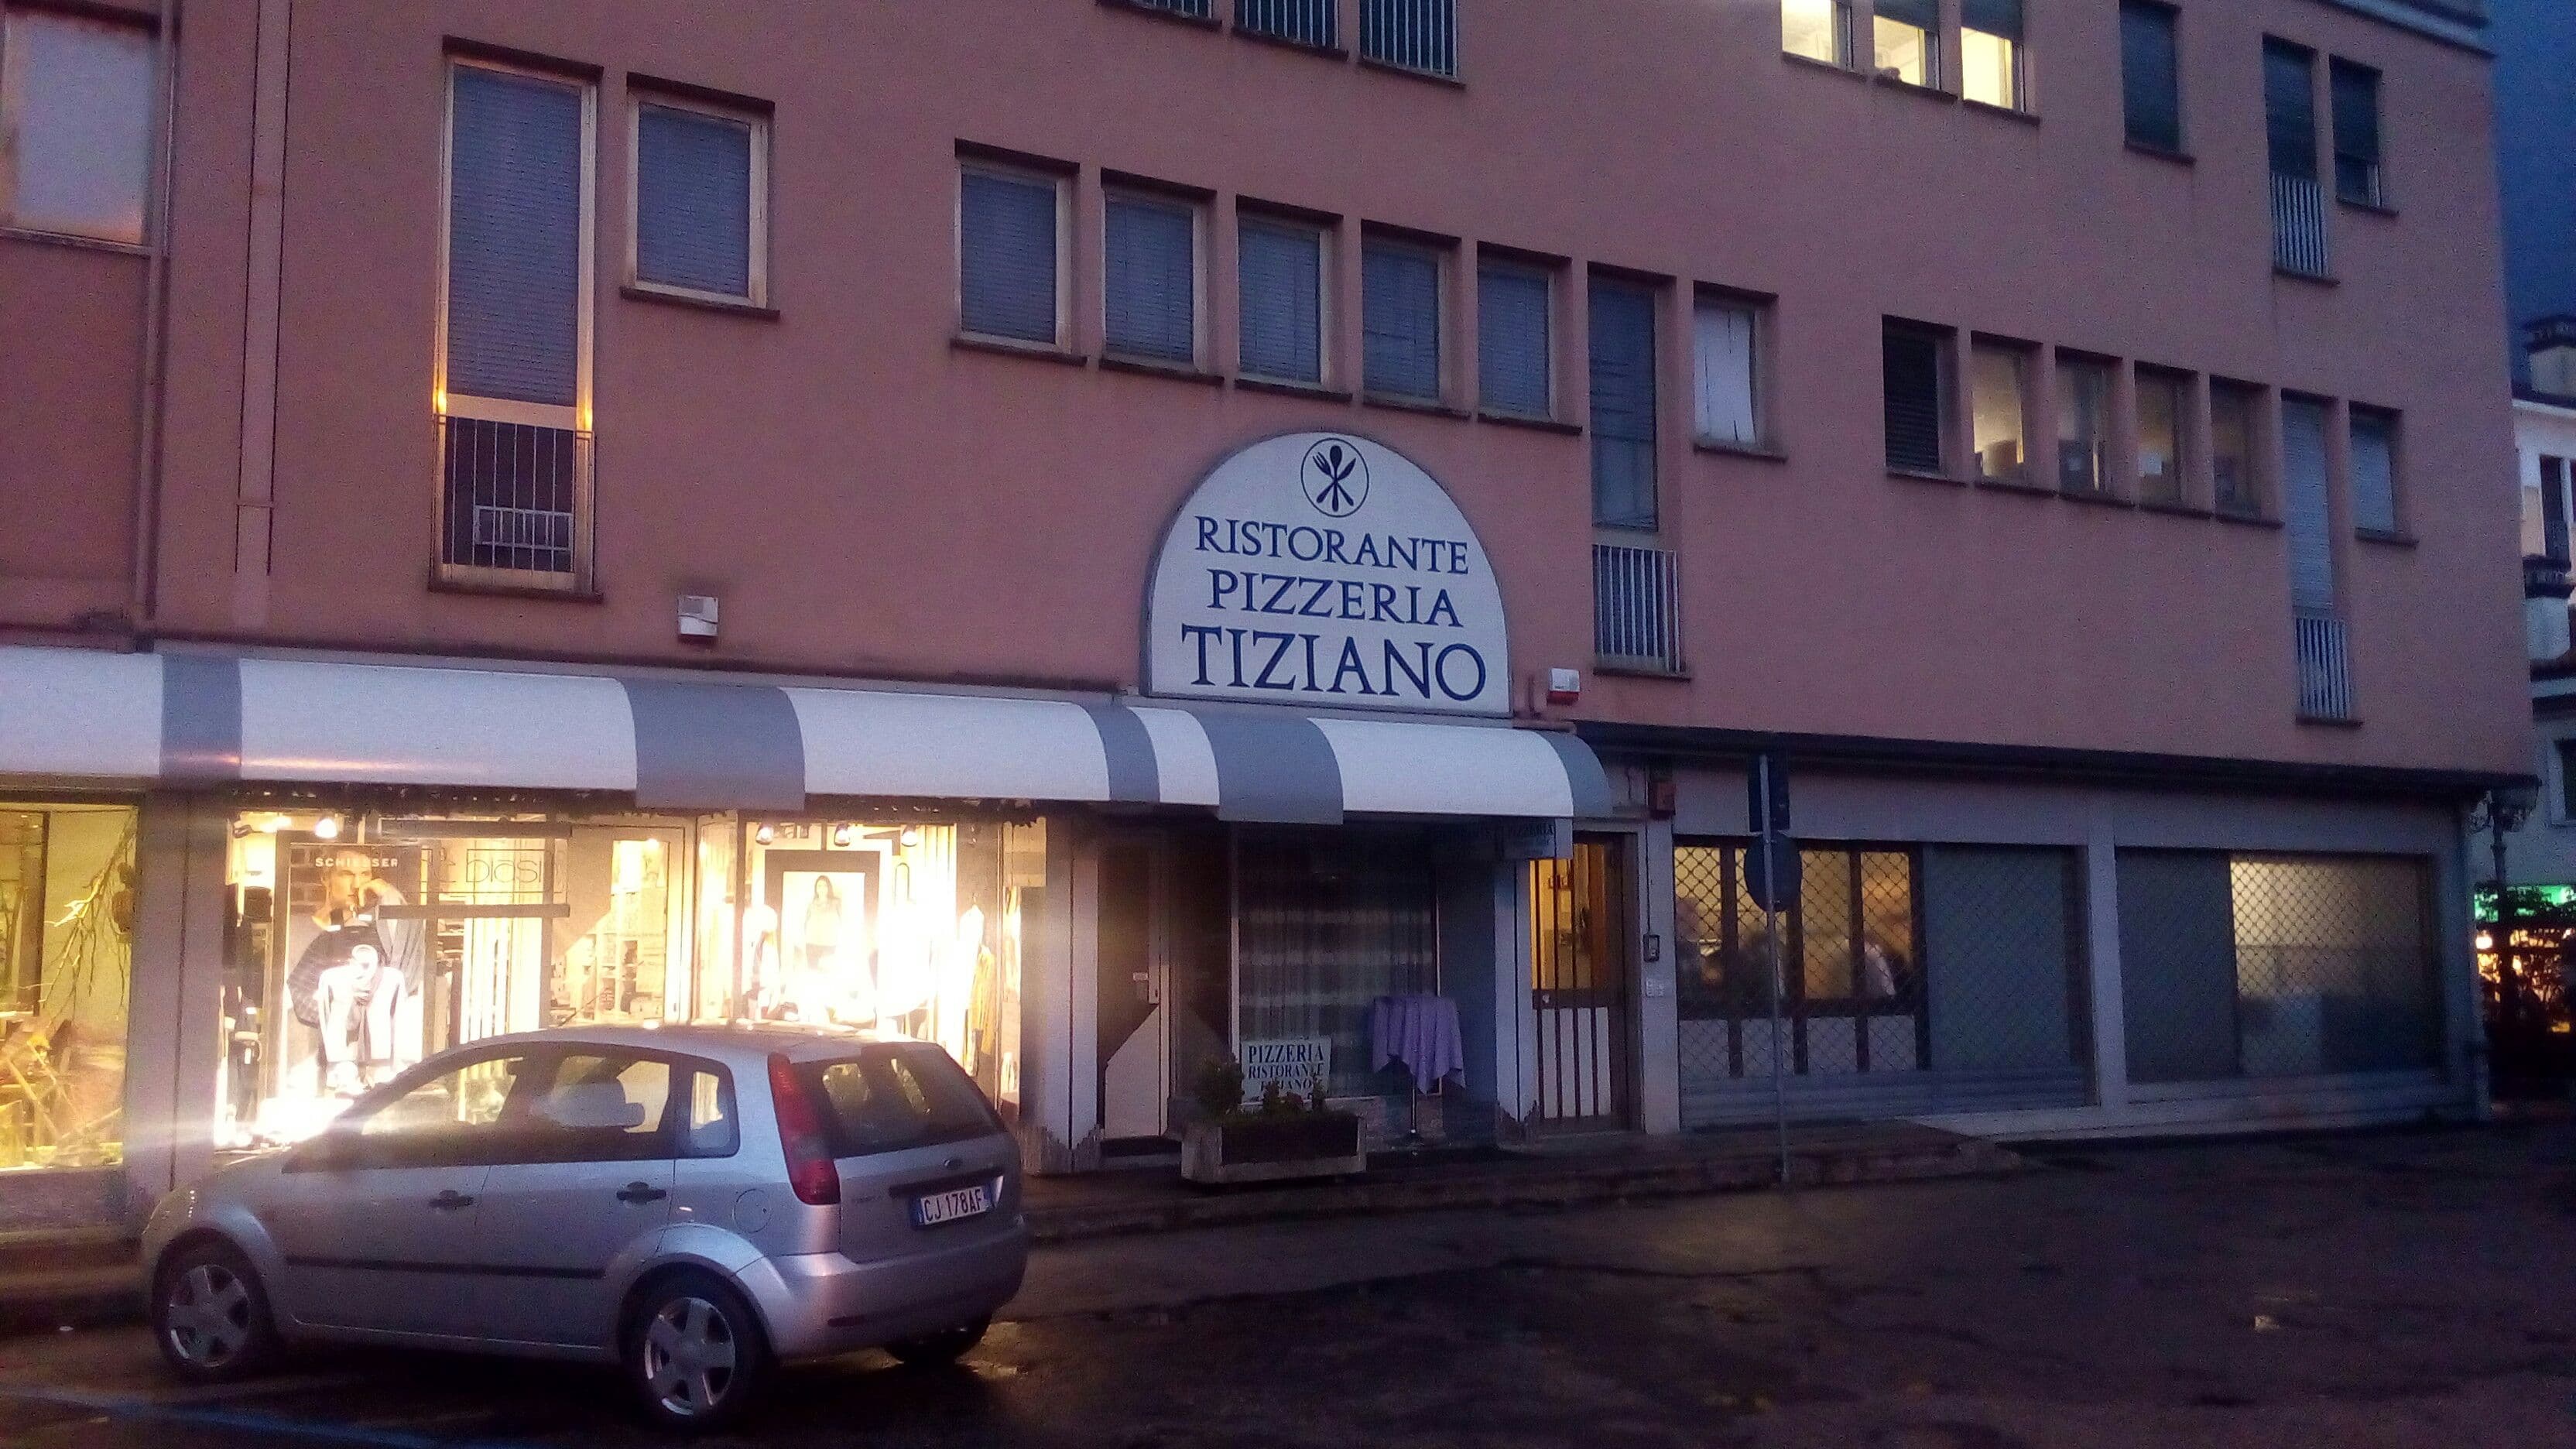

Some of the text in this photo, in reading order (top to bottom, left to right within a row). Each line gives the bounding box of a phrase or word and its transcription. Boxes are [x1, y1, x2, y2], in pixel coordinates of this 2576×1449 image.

[1194, 515, 1469, 575] RISTORANTE
[1206, 568, 1464, 629] PIZZERIA
[1180, 622, 1487, 702] TIZIANO
[315, 857, 398, 868] SCHISER
[1248, 1043, 1324, 1064] PIZZERIA
[1260, 1078, 1312, 1091] TIANO
[923, 1197, 941, 1221] CJ
[945, 1188, 981, 1218] 178AF
